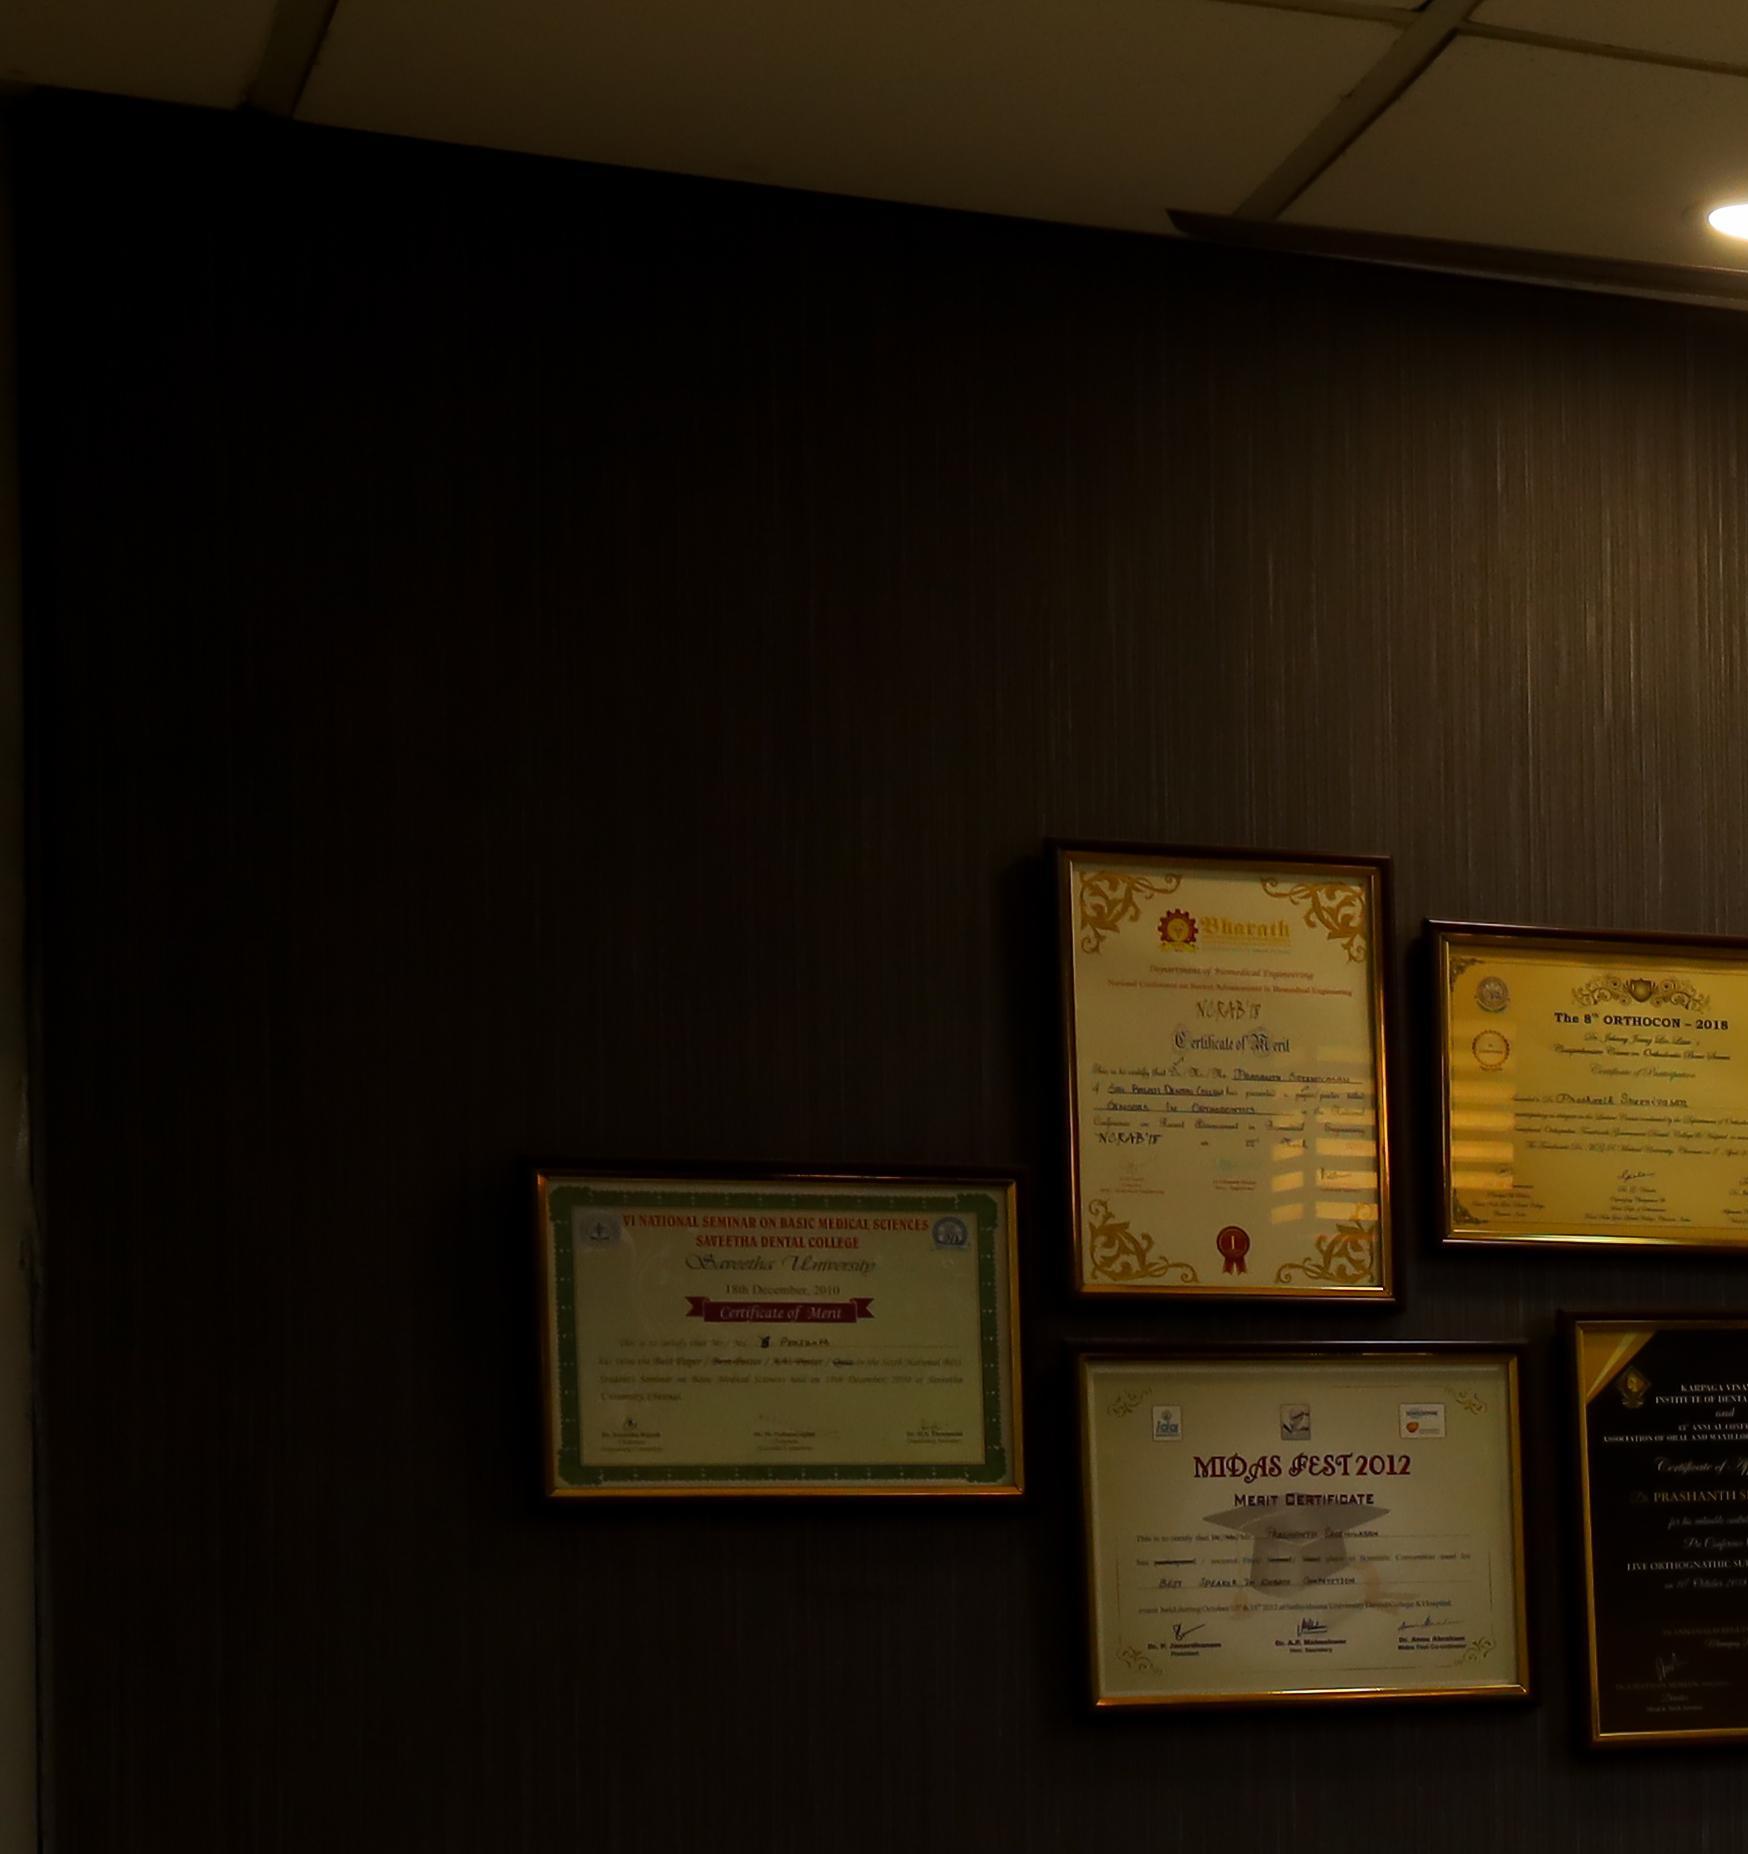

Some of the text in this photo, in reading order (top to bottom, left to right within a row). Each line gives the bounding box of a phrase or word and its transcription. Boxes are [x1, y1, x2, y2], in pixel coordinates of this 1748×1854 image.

[1554, 1011, 1729, 1031] The ORTHOCON 2018
[622, 1213, 929, 1232] VI NATIONAL SEMINAR ON BASIC MEDICAL SCIENCES
[695, 1235, 859, 1249] SAVEETHA DENTAL COLLEGE
[719, 1305, 842, 1321] Certificate of Merit
[1192, 1453, 1411, 1484] MIDAS FEST 2012
[1233, 1492, 1374, 1507] MERIT CERTIFICATE
[1653, 1490, 1736, 1503] PRASHANTH
